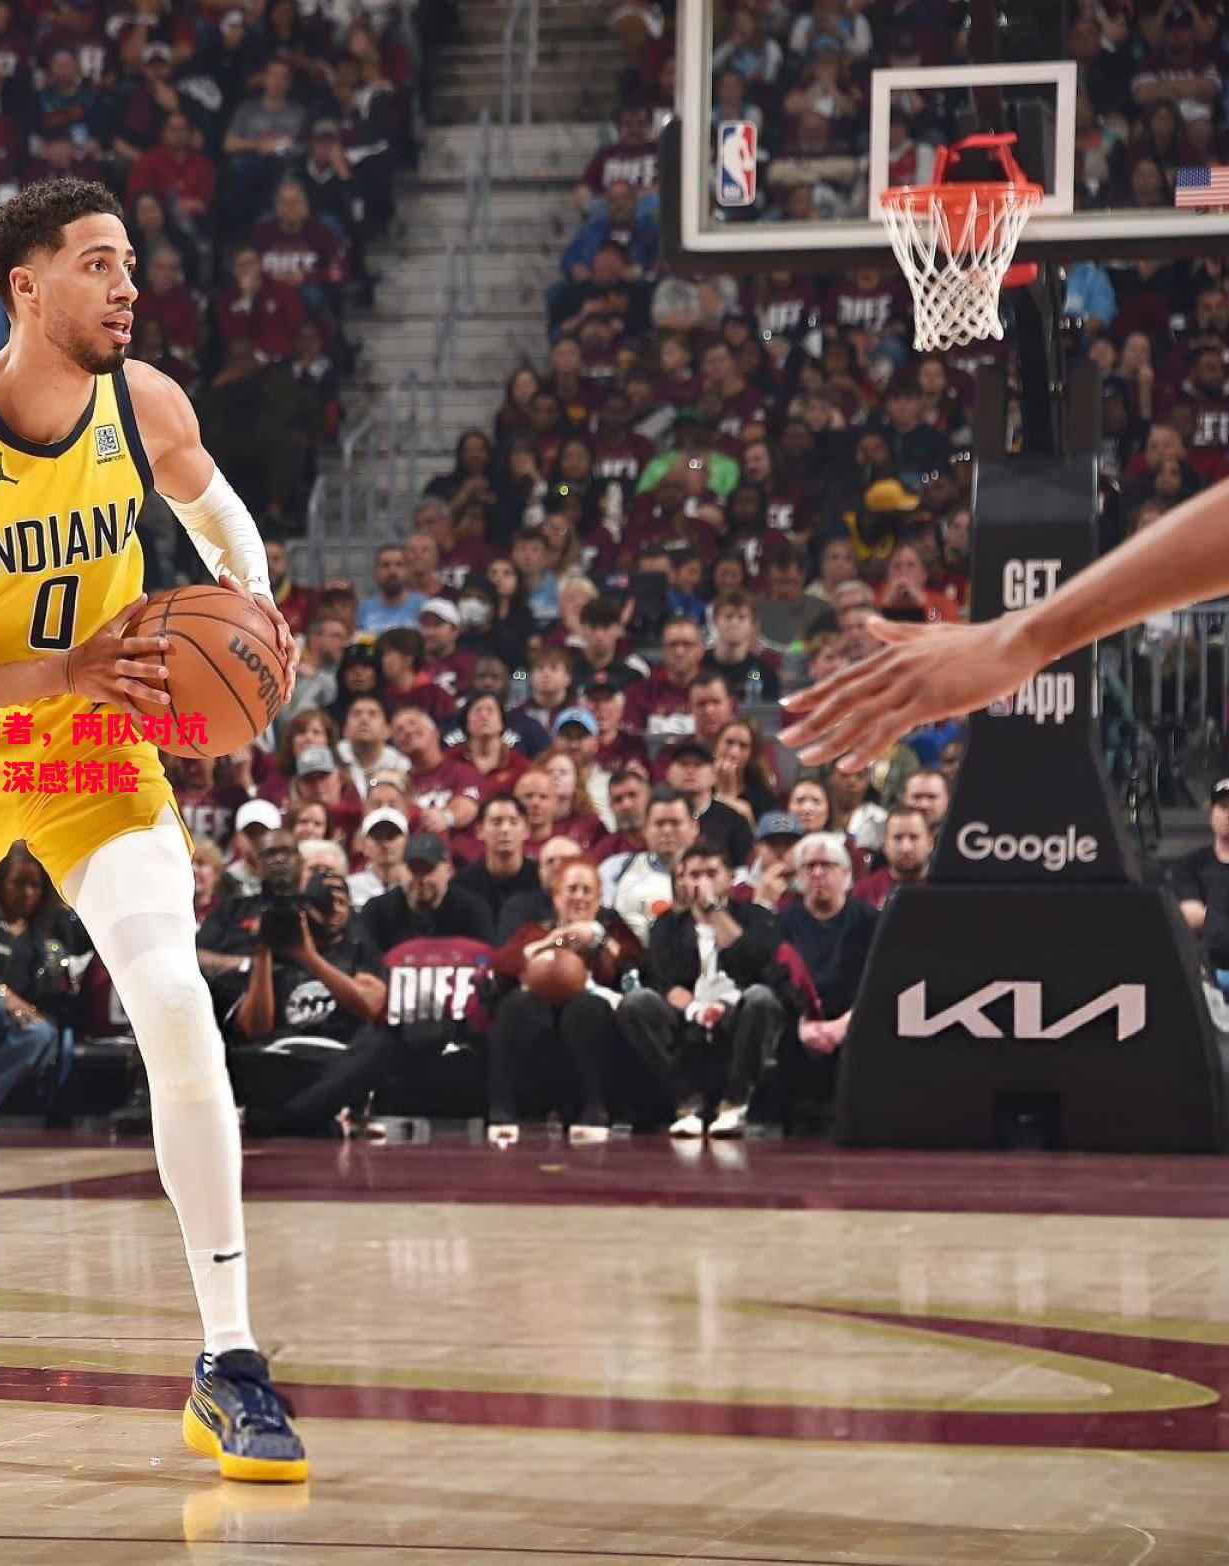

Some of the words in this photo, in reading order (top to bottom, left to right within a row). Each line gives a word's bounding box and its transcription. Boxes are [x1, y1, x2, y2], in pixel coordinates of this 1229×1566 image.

[1002, 558, 1062, 611] GET
[28, 574, 81, 652] 0
[1015, 672, 1075, 725] App
[956, 821, 1098, 872] Google
[897, 979, 1146, 1042] KIA
